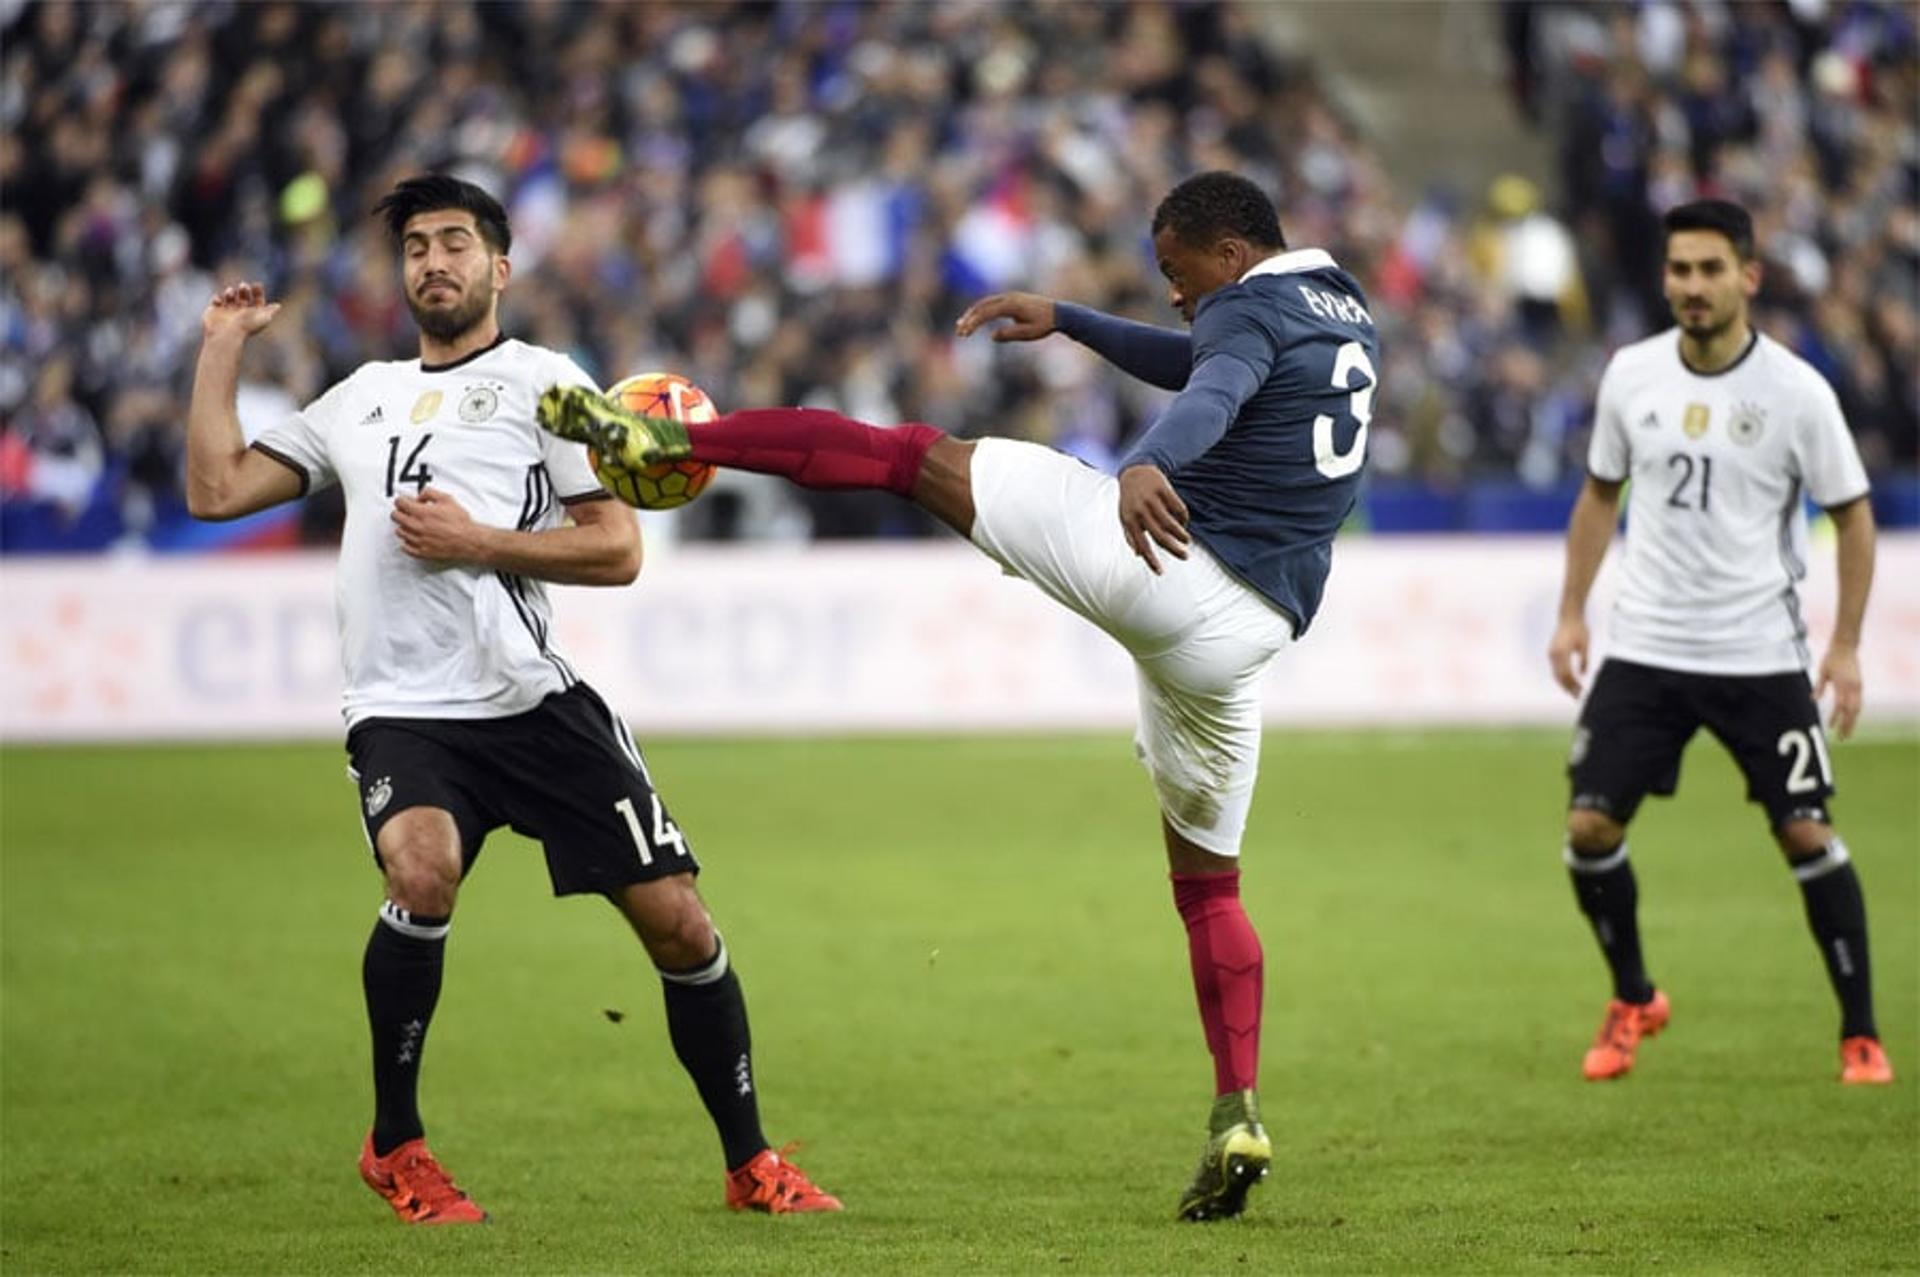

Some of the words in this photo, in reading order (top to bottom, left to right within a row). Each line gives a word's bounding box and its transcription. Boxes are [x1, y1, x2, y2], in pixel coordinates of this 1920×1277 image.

[1297, 284, 1374, 326] EVRA
[1312, 341, 1378, 480] 3
[385, 432, 434, 499] 14
[1667, 452, 1712, 512] 21
[1777, 725, 1833, 794] 21
[613, 792, 687, 866] 14
